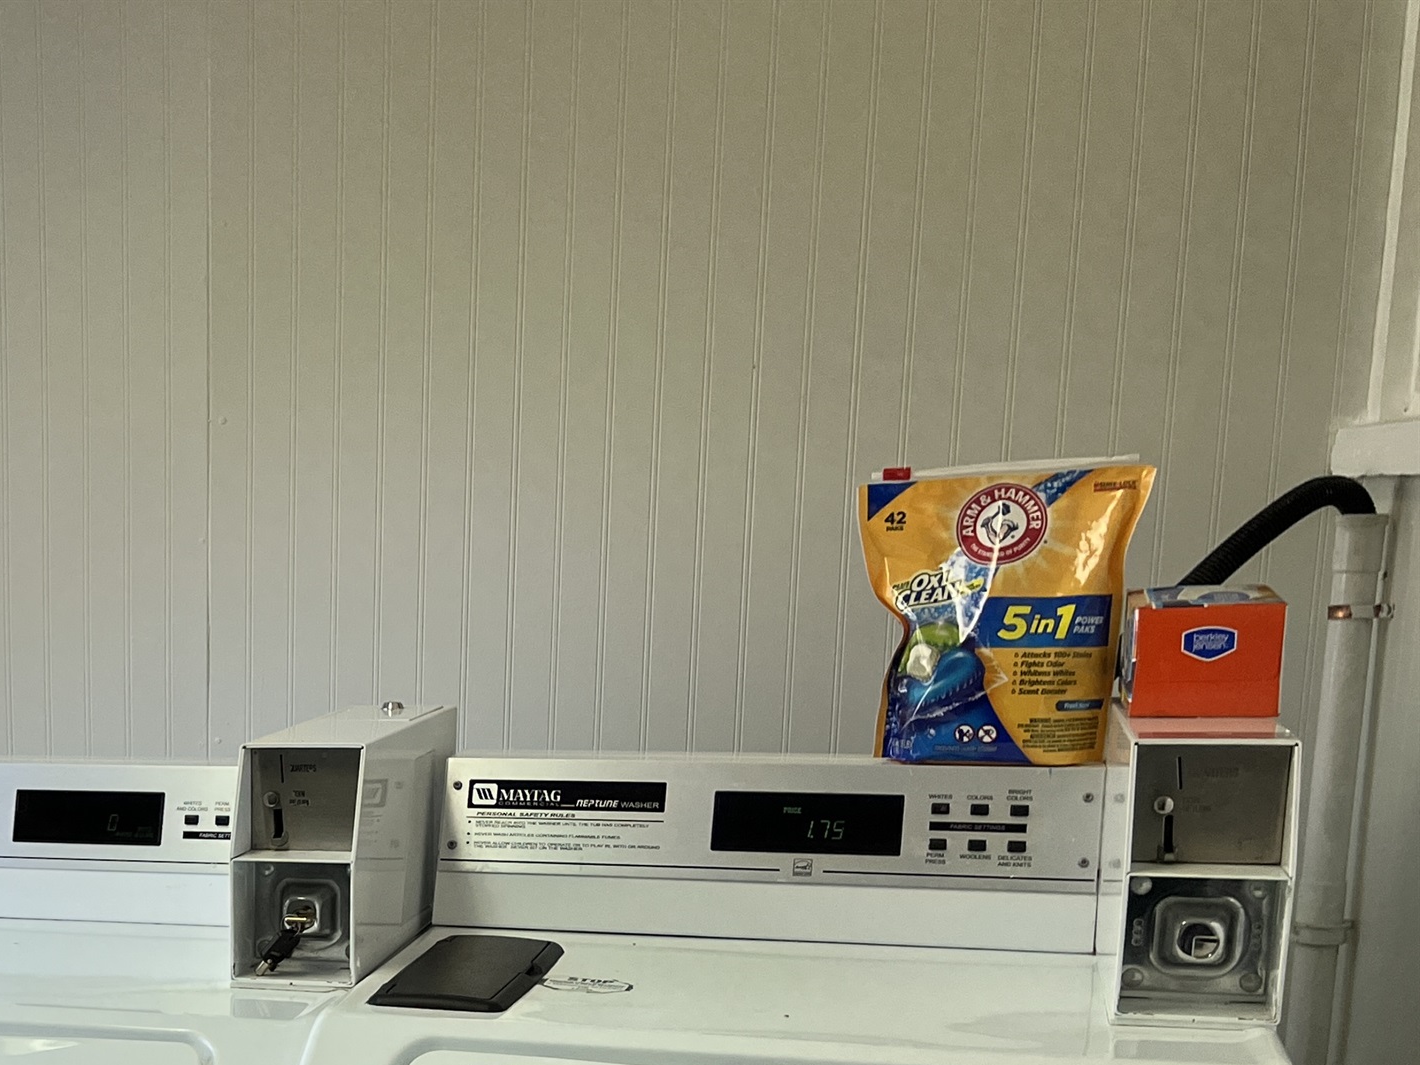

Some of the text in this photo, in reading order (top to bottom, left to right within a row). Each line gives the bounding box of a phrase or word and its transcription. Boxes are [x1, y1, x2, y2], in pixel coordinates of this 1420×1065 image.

[884, 511, 907, 525] 42
[962, 488, 1041, 537] ARM & HAMMER
[1075, 616, 1104, 624] POWER
[1073, 625, 1095, 634] PAKS
[499, 789, 562, 802] MAYTAG
[620, 801, 660, 809] WASHER
[807, 820, 845, 840] 1.75
